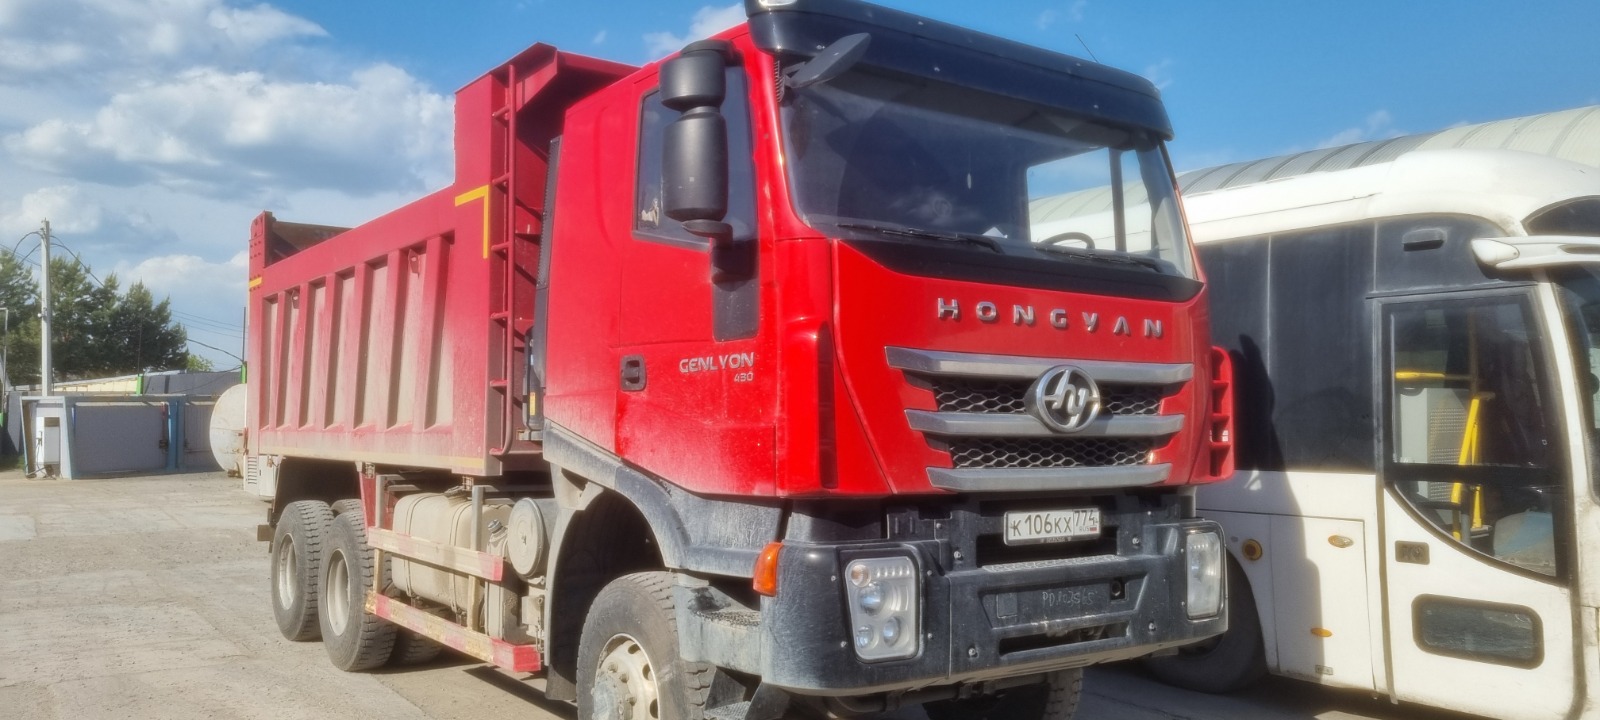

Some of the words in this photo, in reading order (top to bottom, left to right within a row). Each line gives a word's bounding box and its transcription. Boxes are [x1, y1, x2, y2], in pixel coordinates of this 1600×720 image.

[937, 297, 1162, 337] HONGYAN
[679, 352, 754, 373] GENLYON
[734, 371, 754, 382] 430
